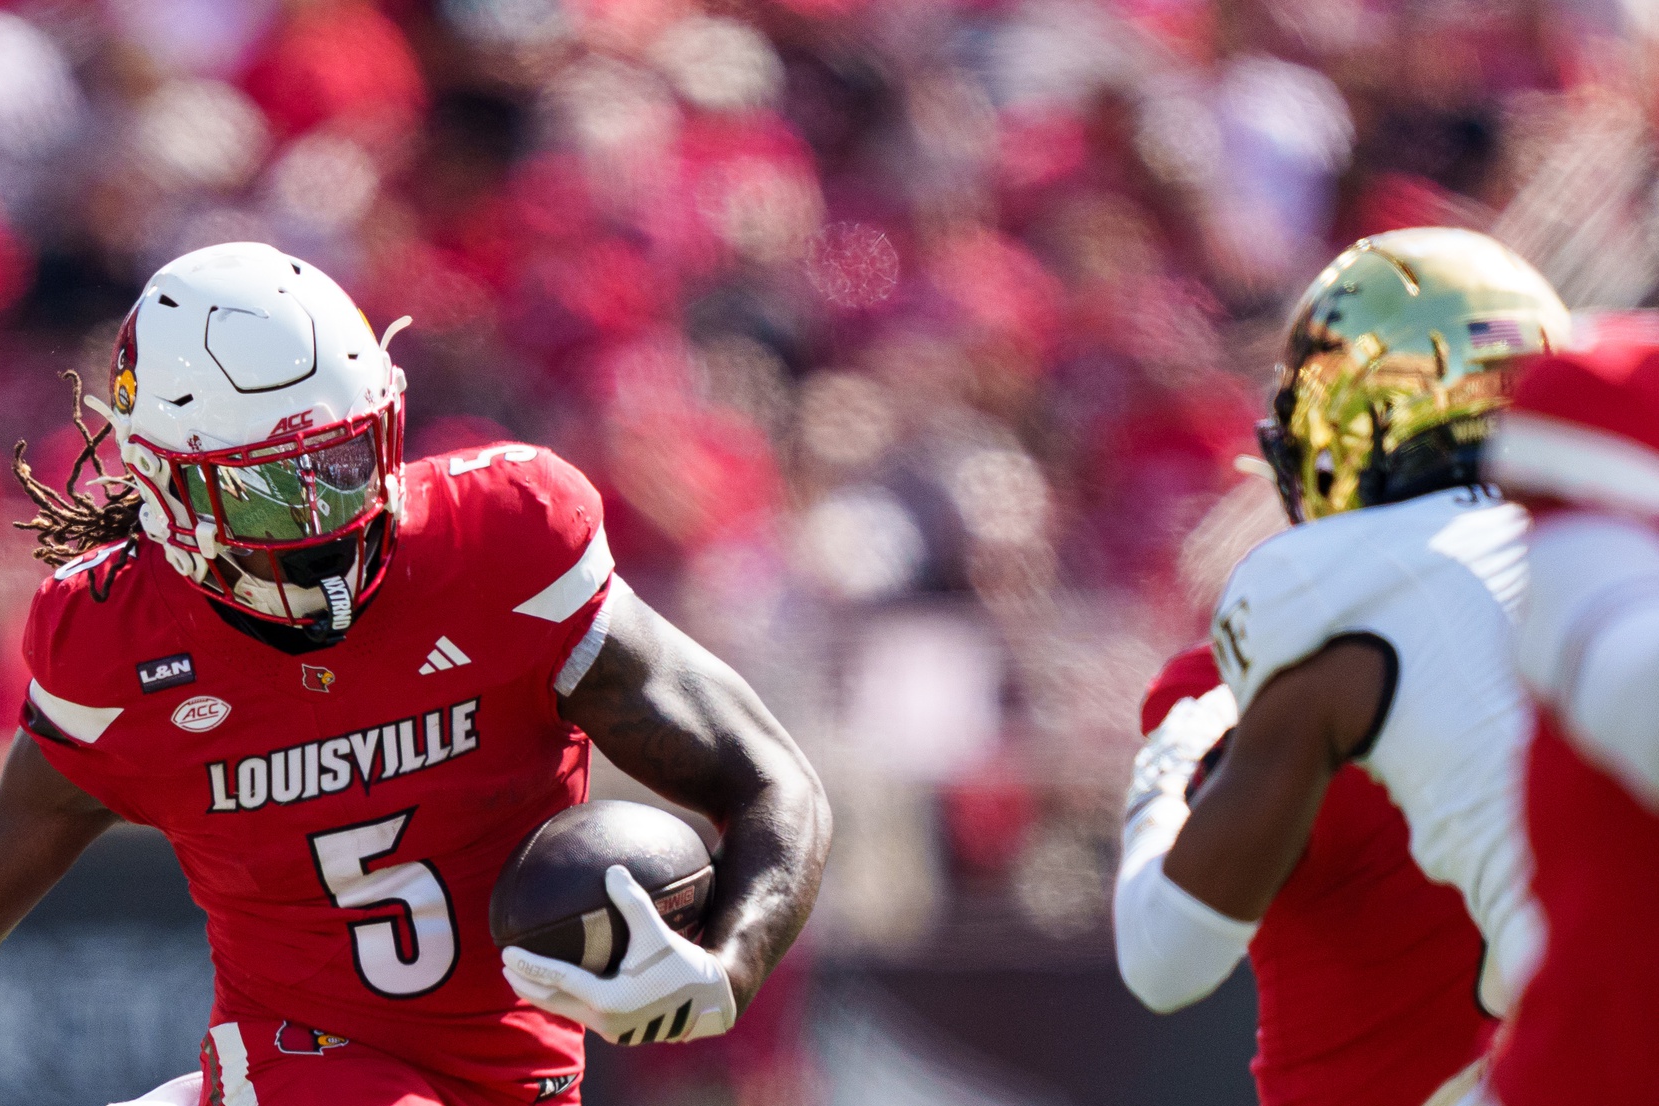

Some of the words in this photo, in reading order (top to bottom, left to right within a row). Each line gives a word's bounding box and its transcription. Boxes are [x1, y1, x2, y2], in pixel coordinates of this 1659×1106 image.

[269, 408, 314, 437] ACC
[320, 575, 352, 630] NXTRND
[139, 659, 192, 684] L&N
[183, 702, 219, 721] ACC
[205, 695, 482, 814] LOUISVILLE
[306, 804, 461, 1001] 5
